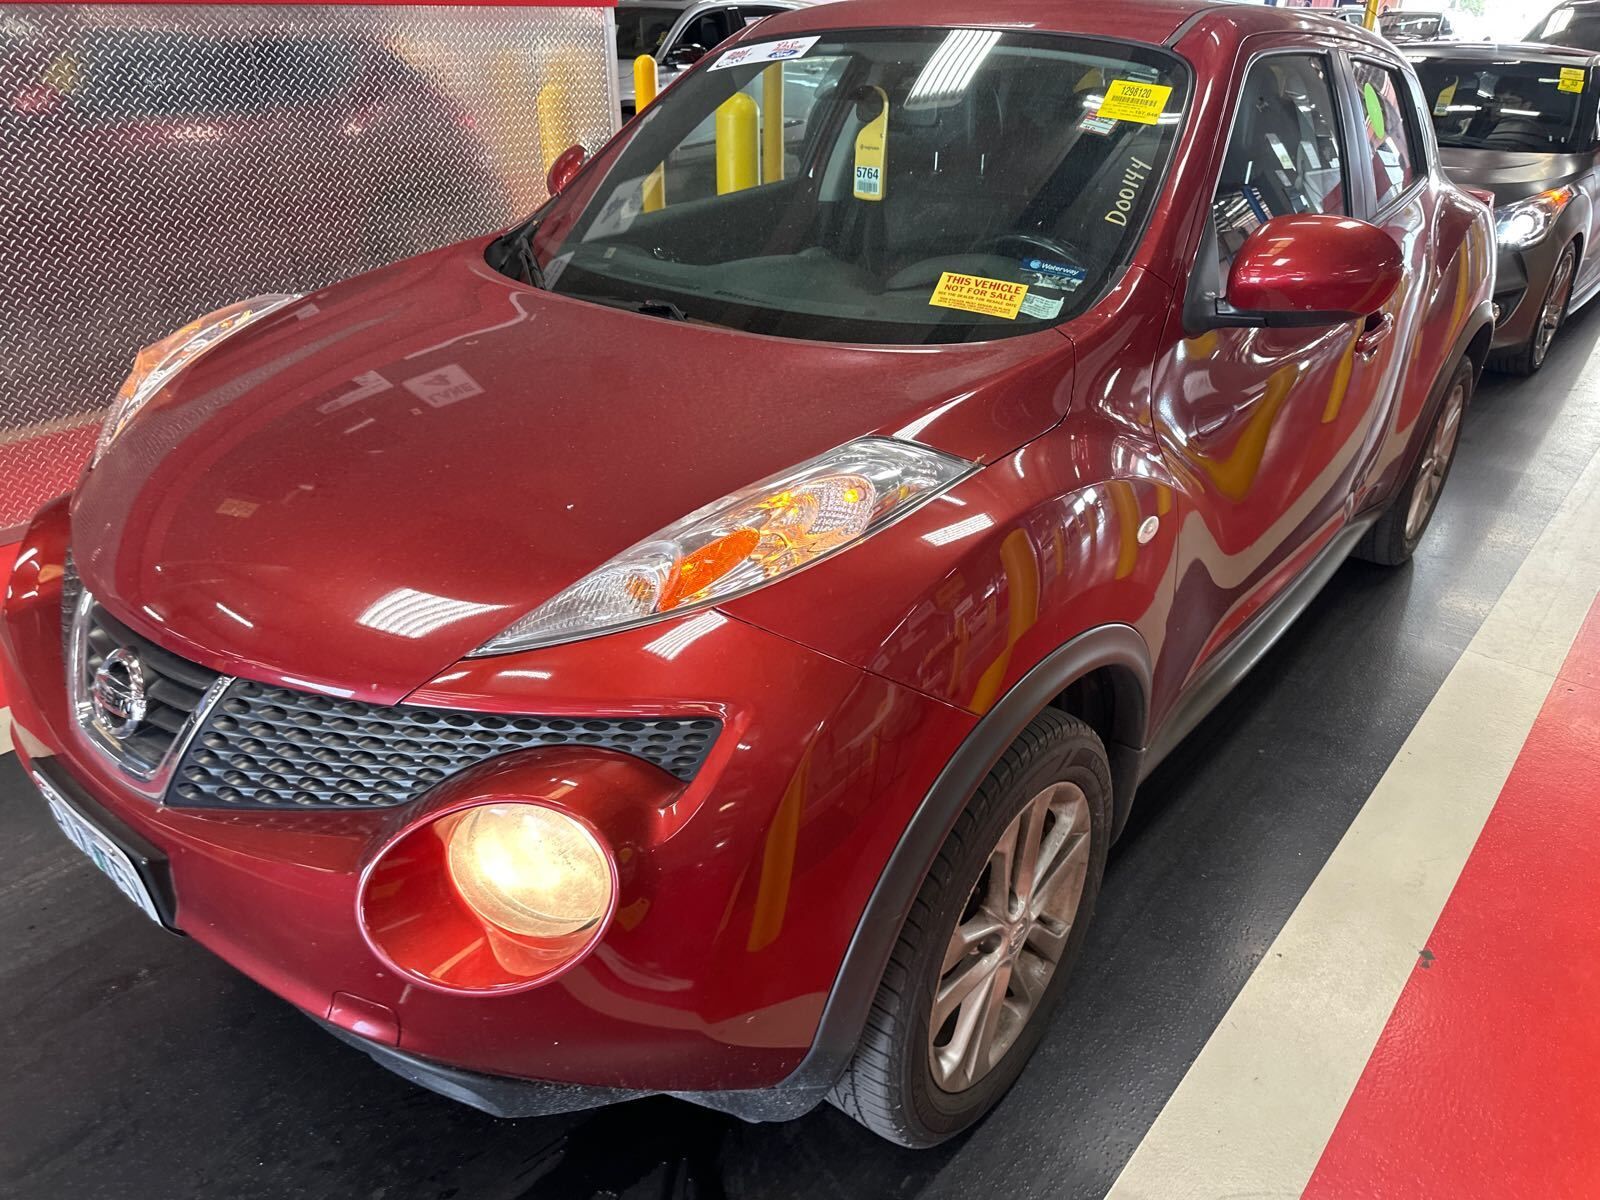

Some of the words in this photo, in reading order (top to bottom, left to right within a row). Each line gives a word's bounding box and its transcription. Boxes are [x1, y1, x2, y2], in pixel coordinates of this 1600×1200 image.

[1121, 86, 1153, 98] 1298120
[856, 166, 879, 180] 5764
[1042, 262, 1080, 276] Waterway
[946, 275, 972, 286] THIS
[974, 279, 1023, 294] VEHICLE
[944, 284, 965, 292] NOT
[966, 287, 988, 296] FOR
[990, 292, 1016, 302] SALE
